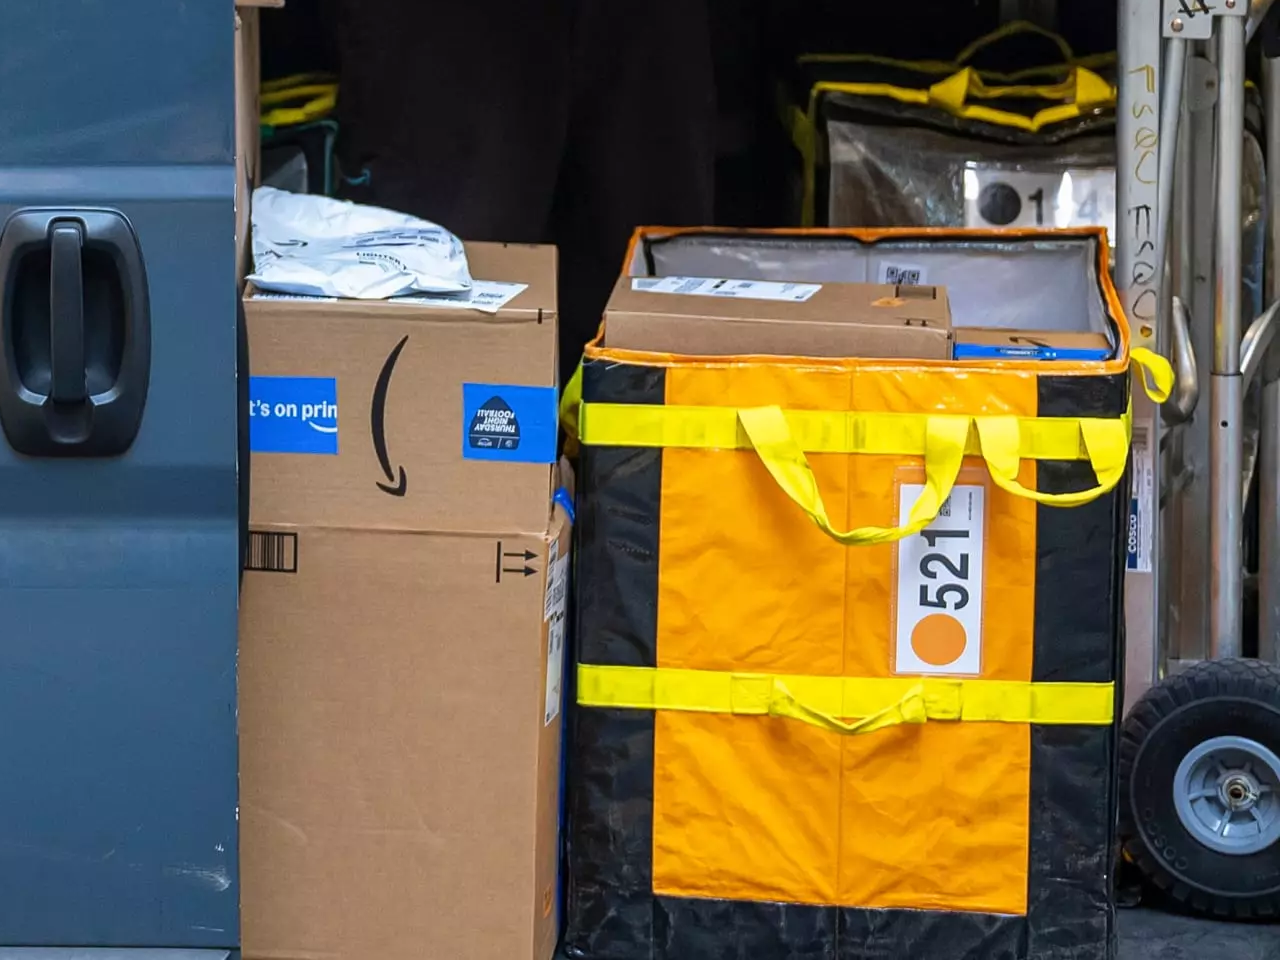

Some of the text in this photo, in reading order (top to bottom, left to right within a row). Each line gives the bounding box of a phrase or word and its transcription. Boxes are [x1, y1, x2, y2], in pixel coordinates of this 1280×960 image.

[274, 403, 297, 417] on
[474, 423, 515, 433] THURSDAY
[1128, 514, 1137, 554] COSCO
[920, 530, 970, 611] 521
[1144, 807, 1189, 870] COSCO
